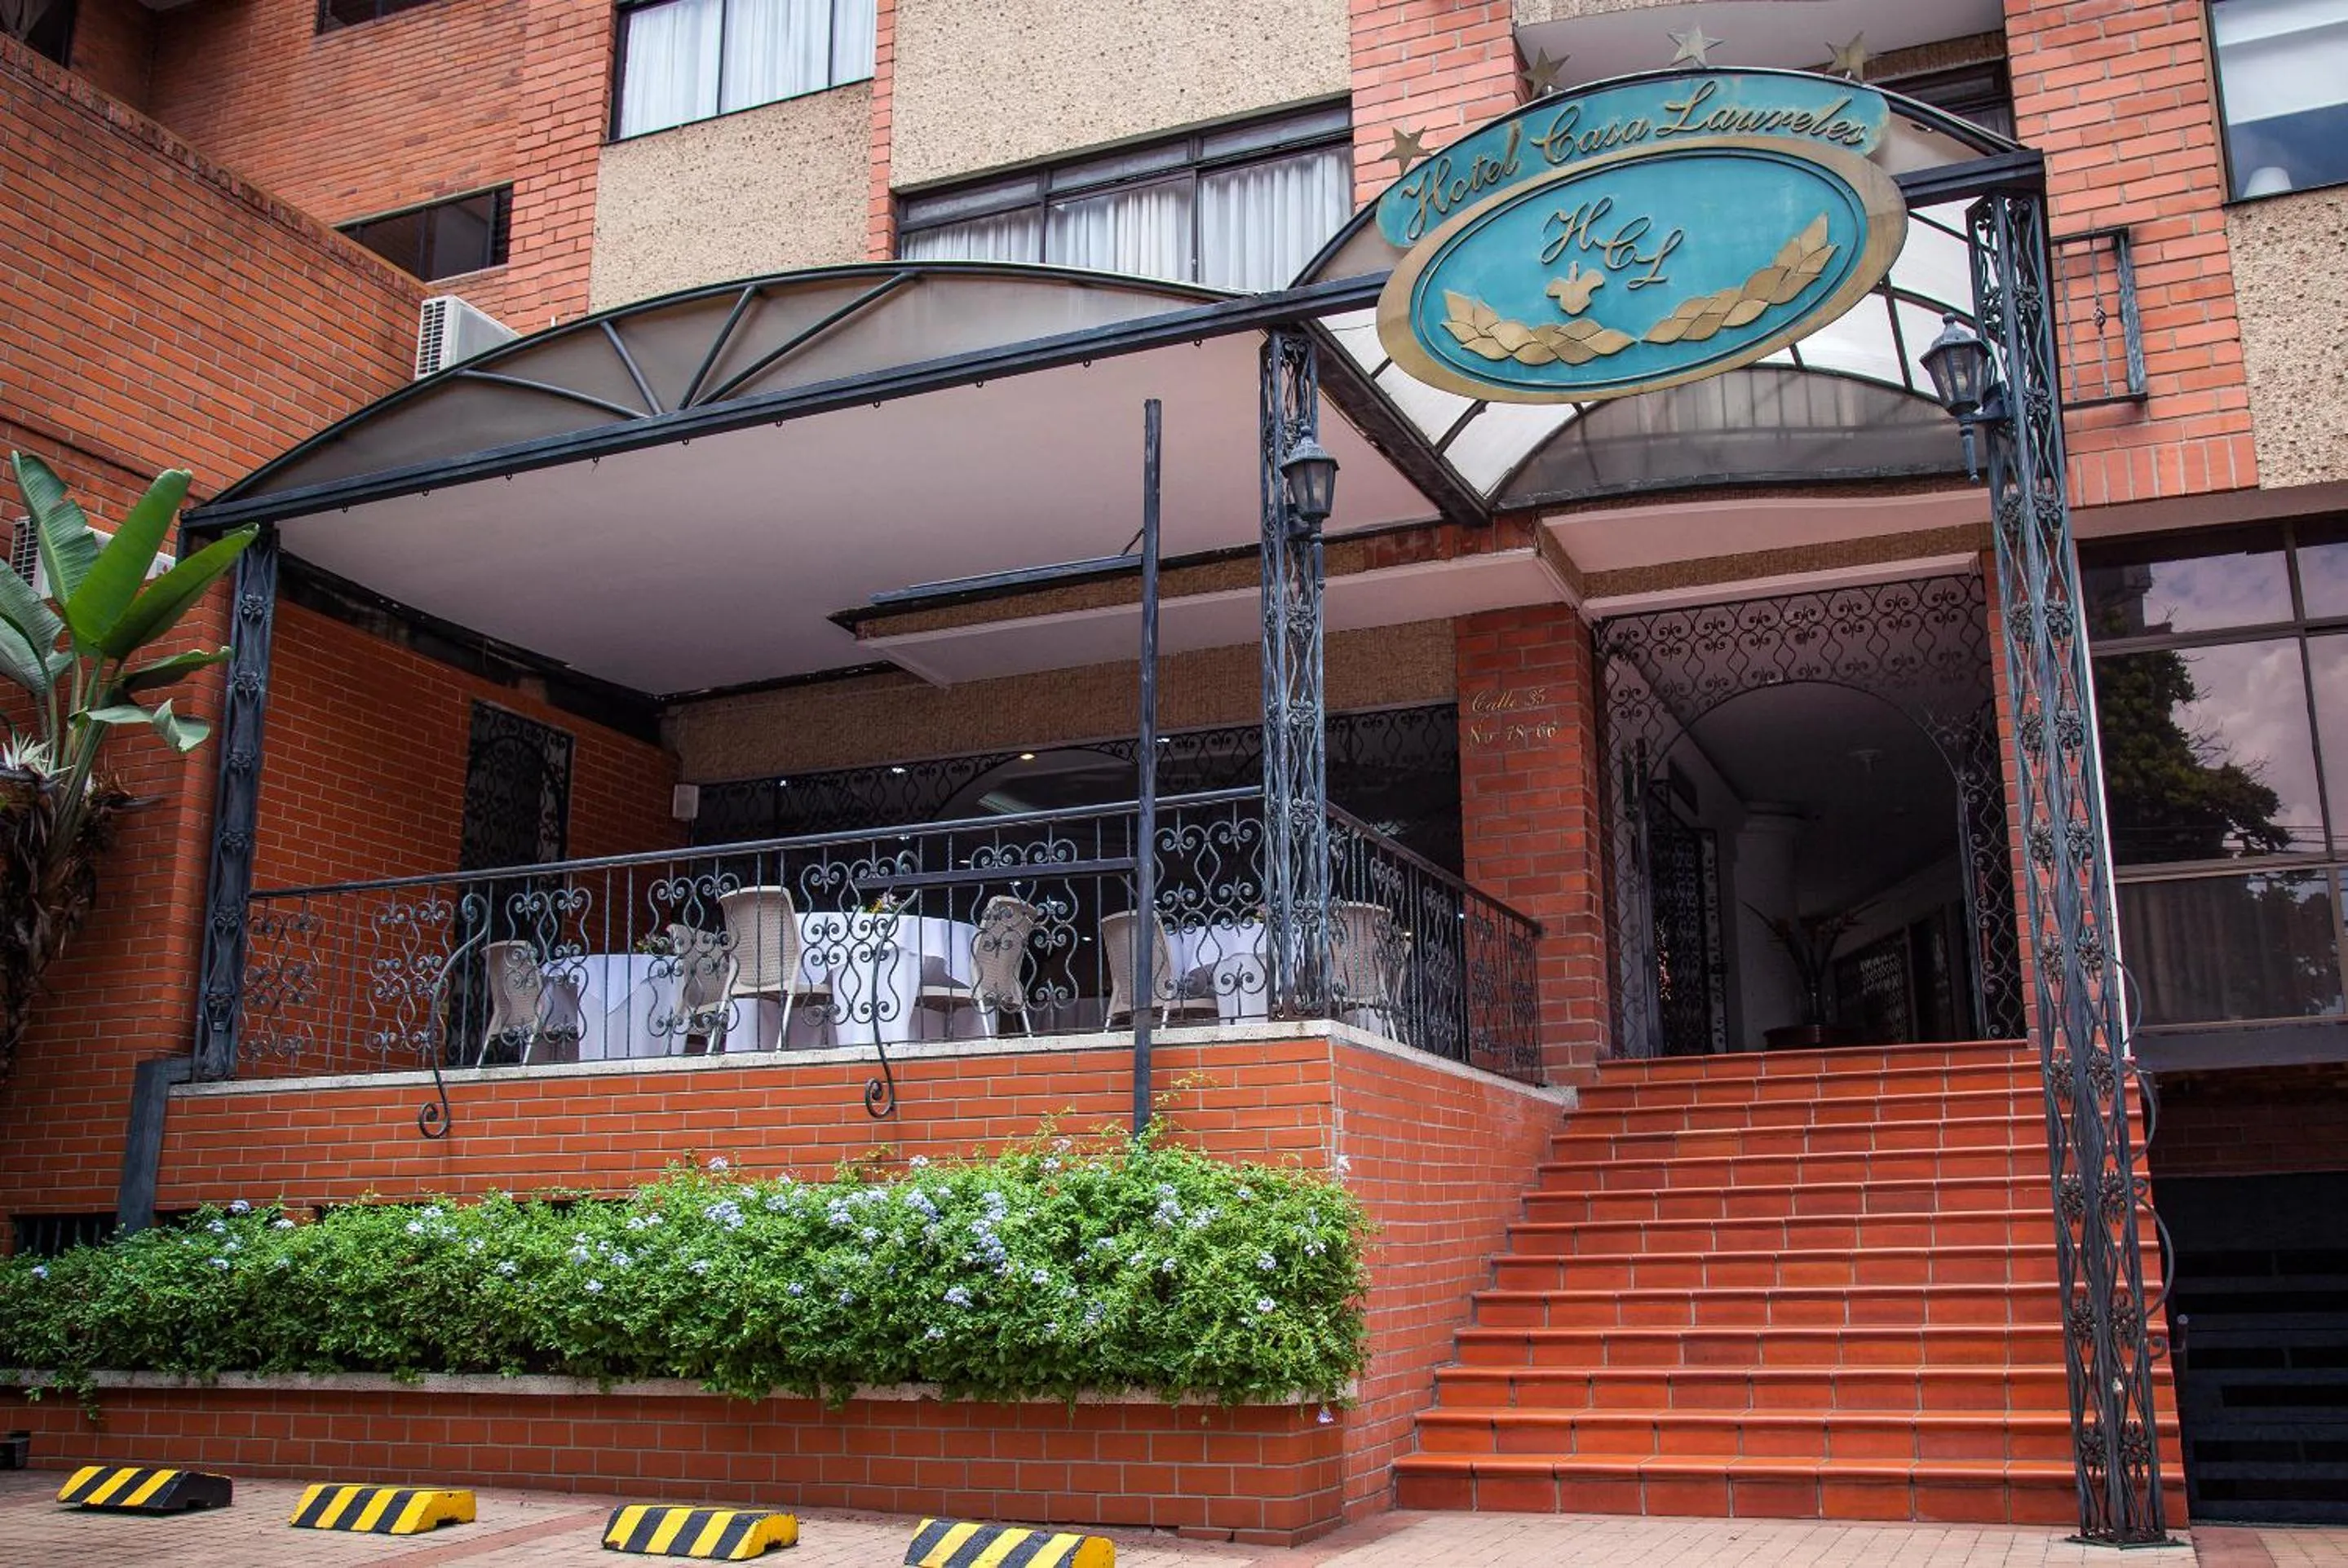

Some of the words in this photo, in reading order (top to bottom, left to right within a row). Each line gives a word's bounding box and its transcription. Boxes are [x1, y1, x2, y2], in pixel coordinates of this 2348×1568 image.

[1400, 121, 1521, 240] Hotel
[1530, 104, 1649, 164] Casa
[1655, 80, 1867, 145] Laureles
[1471, 690, 1515, 712] Calle
